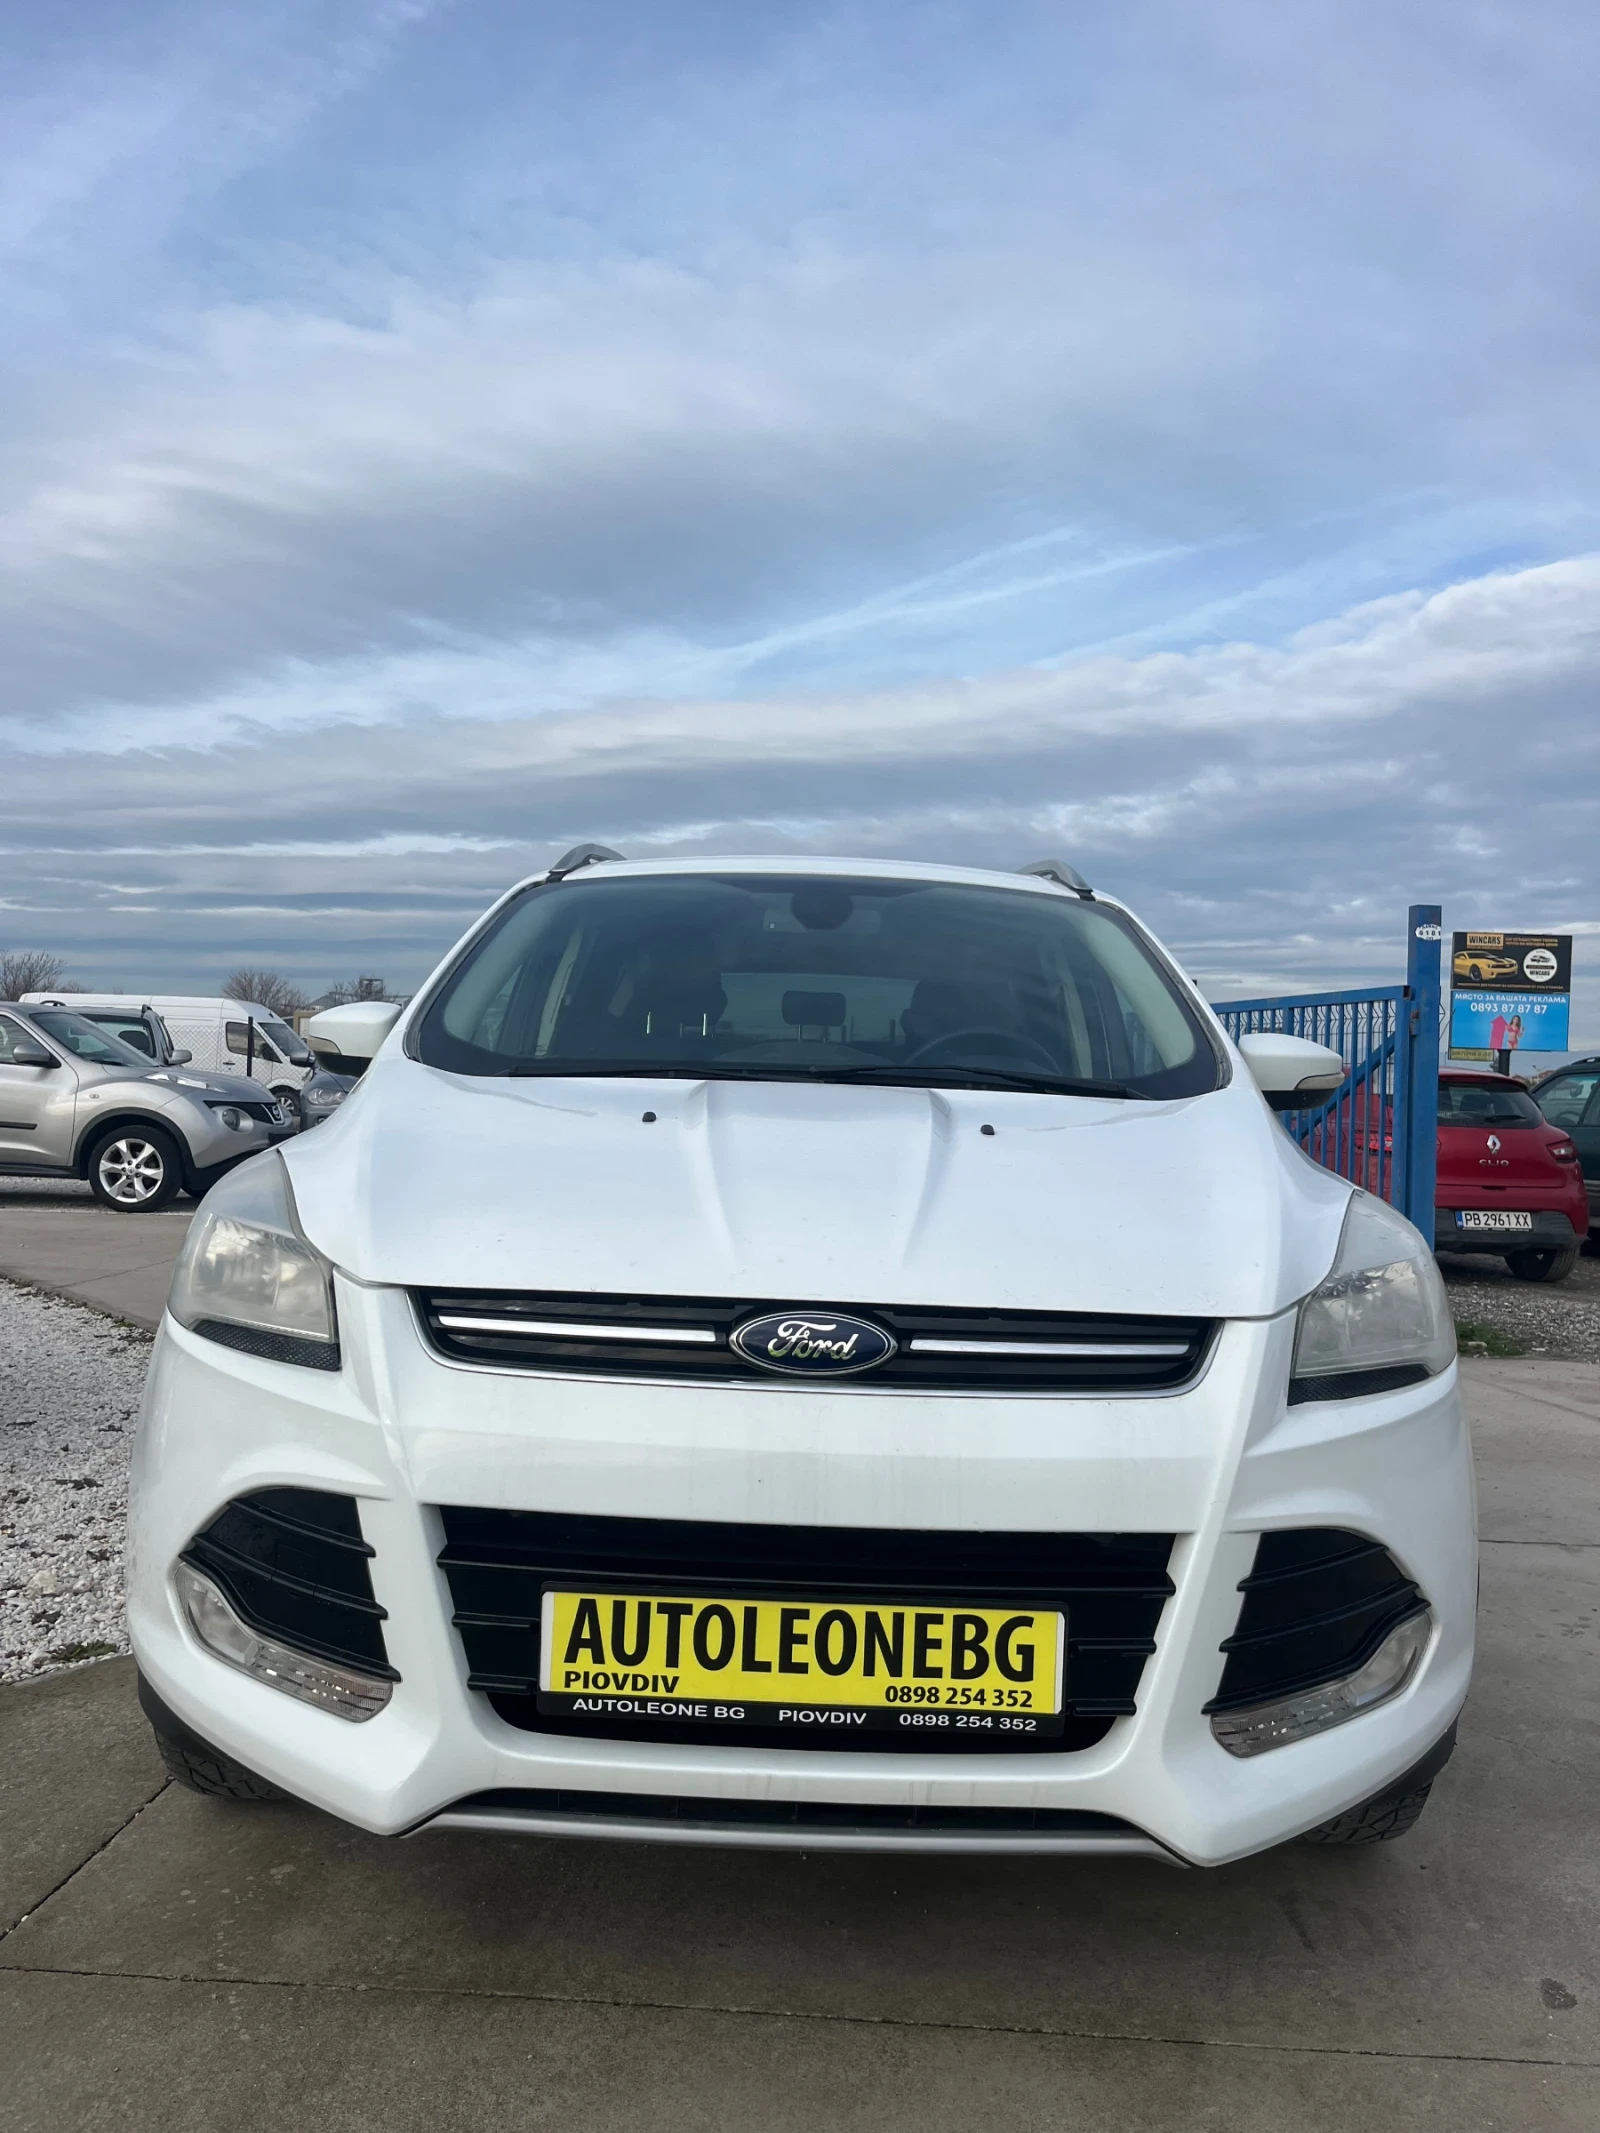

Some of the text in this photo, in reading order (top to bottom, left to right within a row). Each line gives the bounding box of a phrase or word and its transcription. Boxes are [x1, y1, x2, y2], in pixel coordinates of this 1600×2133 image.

[1469, 935, 1501, 945] WINCARS
[1470, 1003, 1547, 1014] 0893 87 87 87
[1464, 1213, 1530, 1227] PB 2961 XX
[767, 1320, 859, 1360] Ford
[563, 1598, 1035, 1683] AUTOLEONEBG
[564, 1670, 680, 1694] PIOVDIV
[885, 1685, 1033, 1708] 0898 254 352
[573, 1698, 708, 1717] AUTOLEONE
[714, 1706, 746, 1719] BG
[899, 1713, 950, 1726] 0898
[955, 1715, 994, 1728] 254
[998, 1717, 1037, 1731] 352
